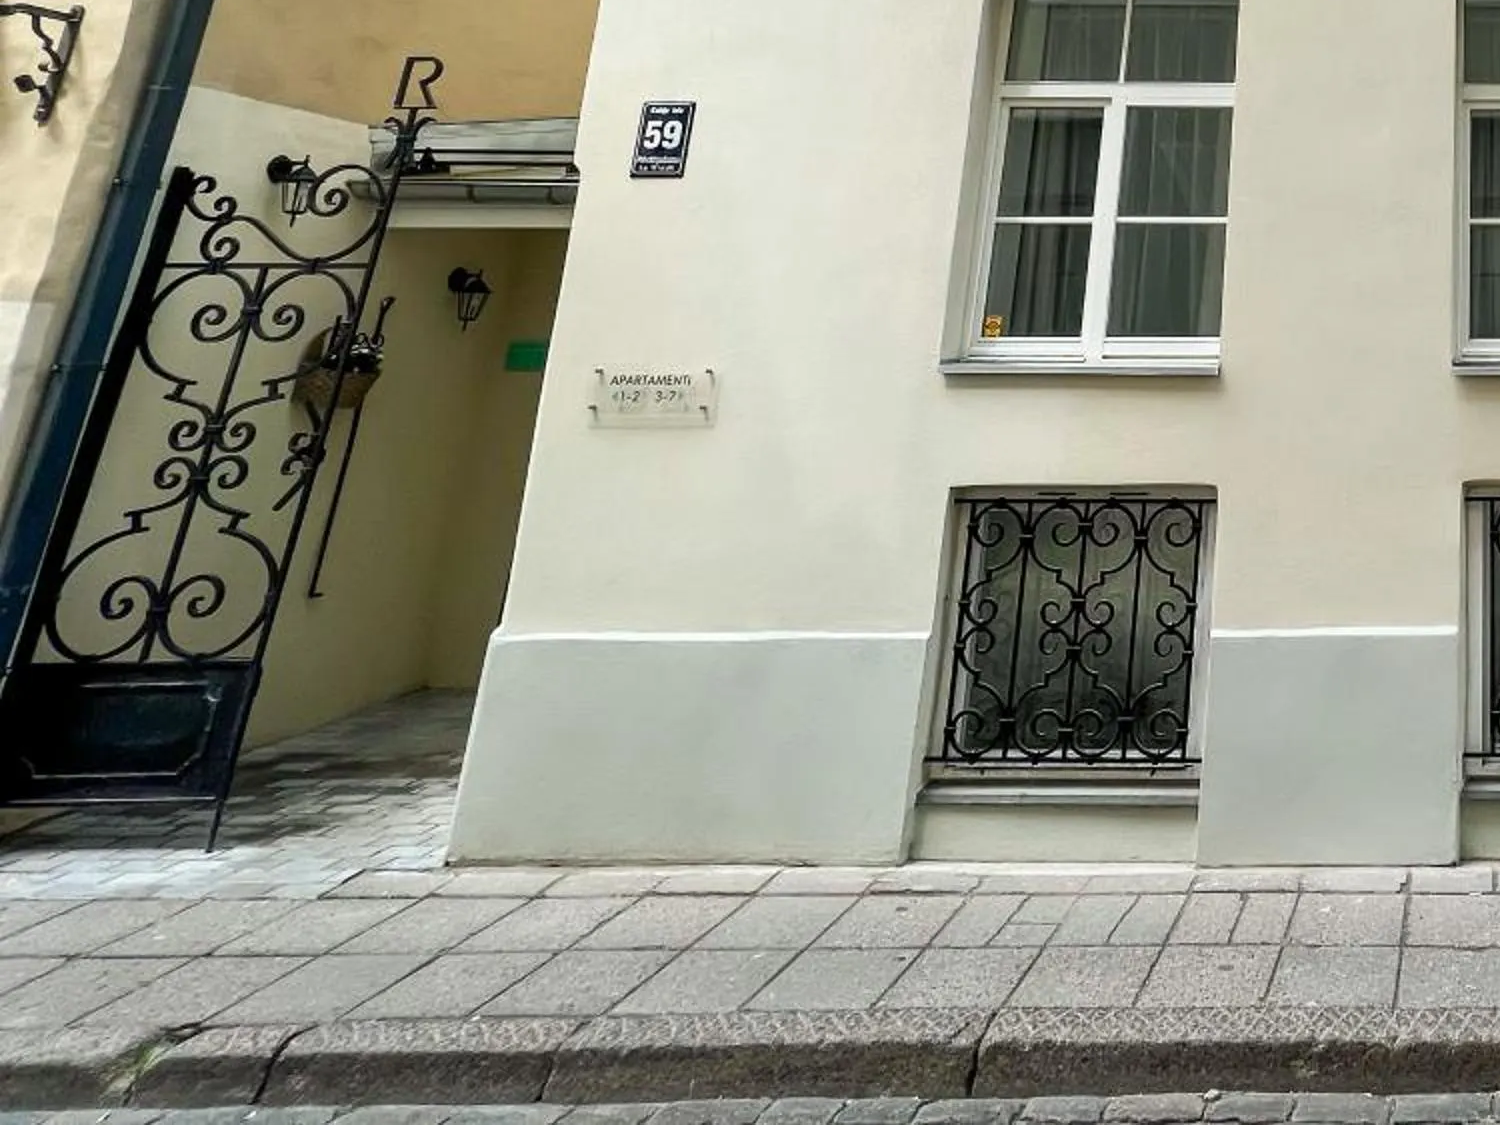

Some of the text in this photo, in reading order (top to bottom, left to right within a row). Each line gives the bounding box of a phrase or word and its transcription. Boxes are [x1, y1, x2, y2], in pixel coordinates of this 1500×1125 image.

[393, 56, 445, 110] R
[643, 120, 683, 149] 59
[609, 374, 691, 386] APARTAMENTI
